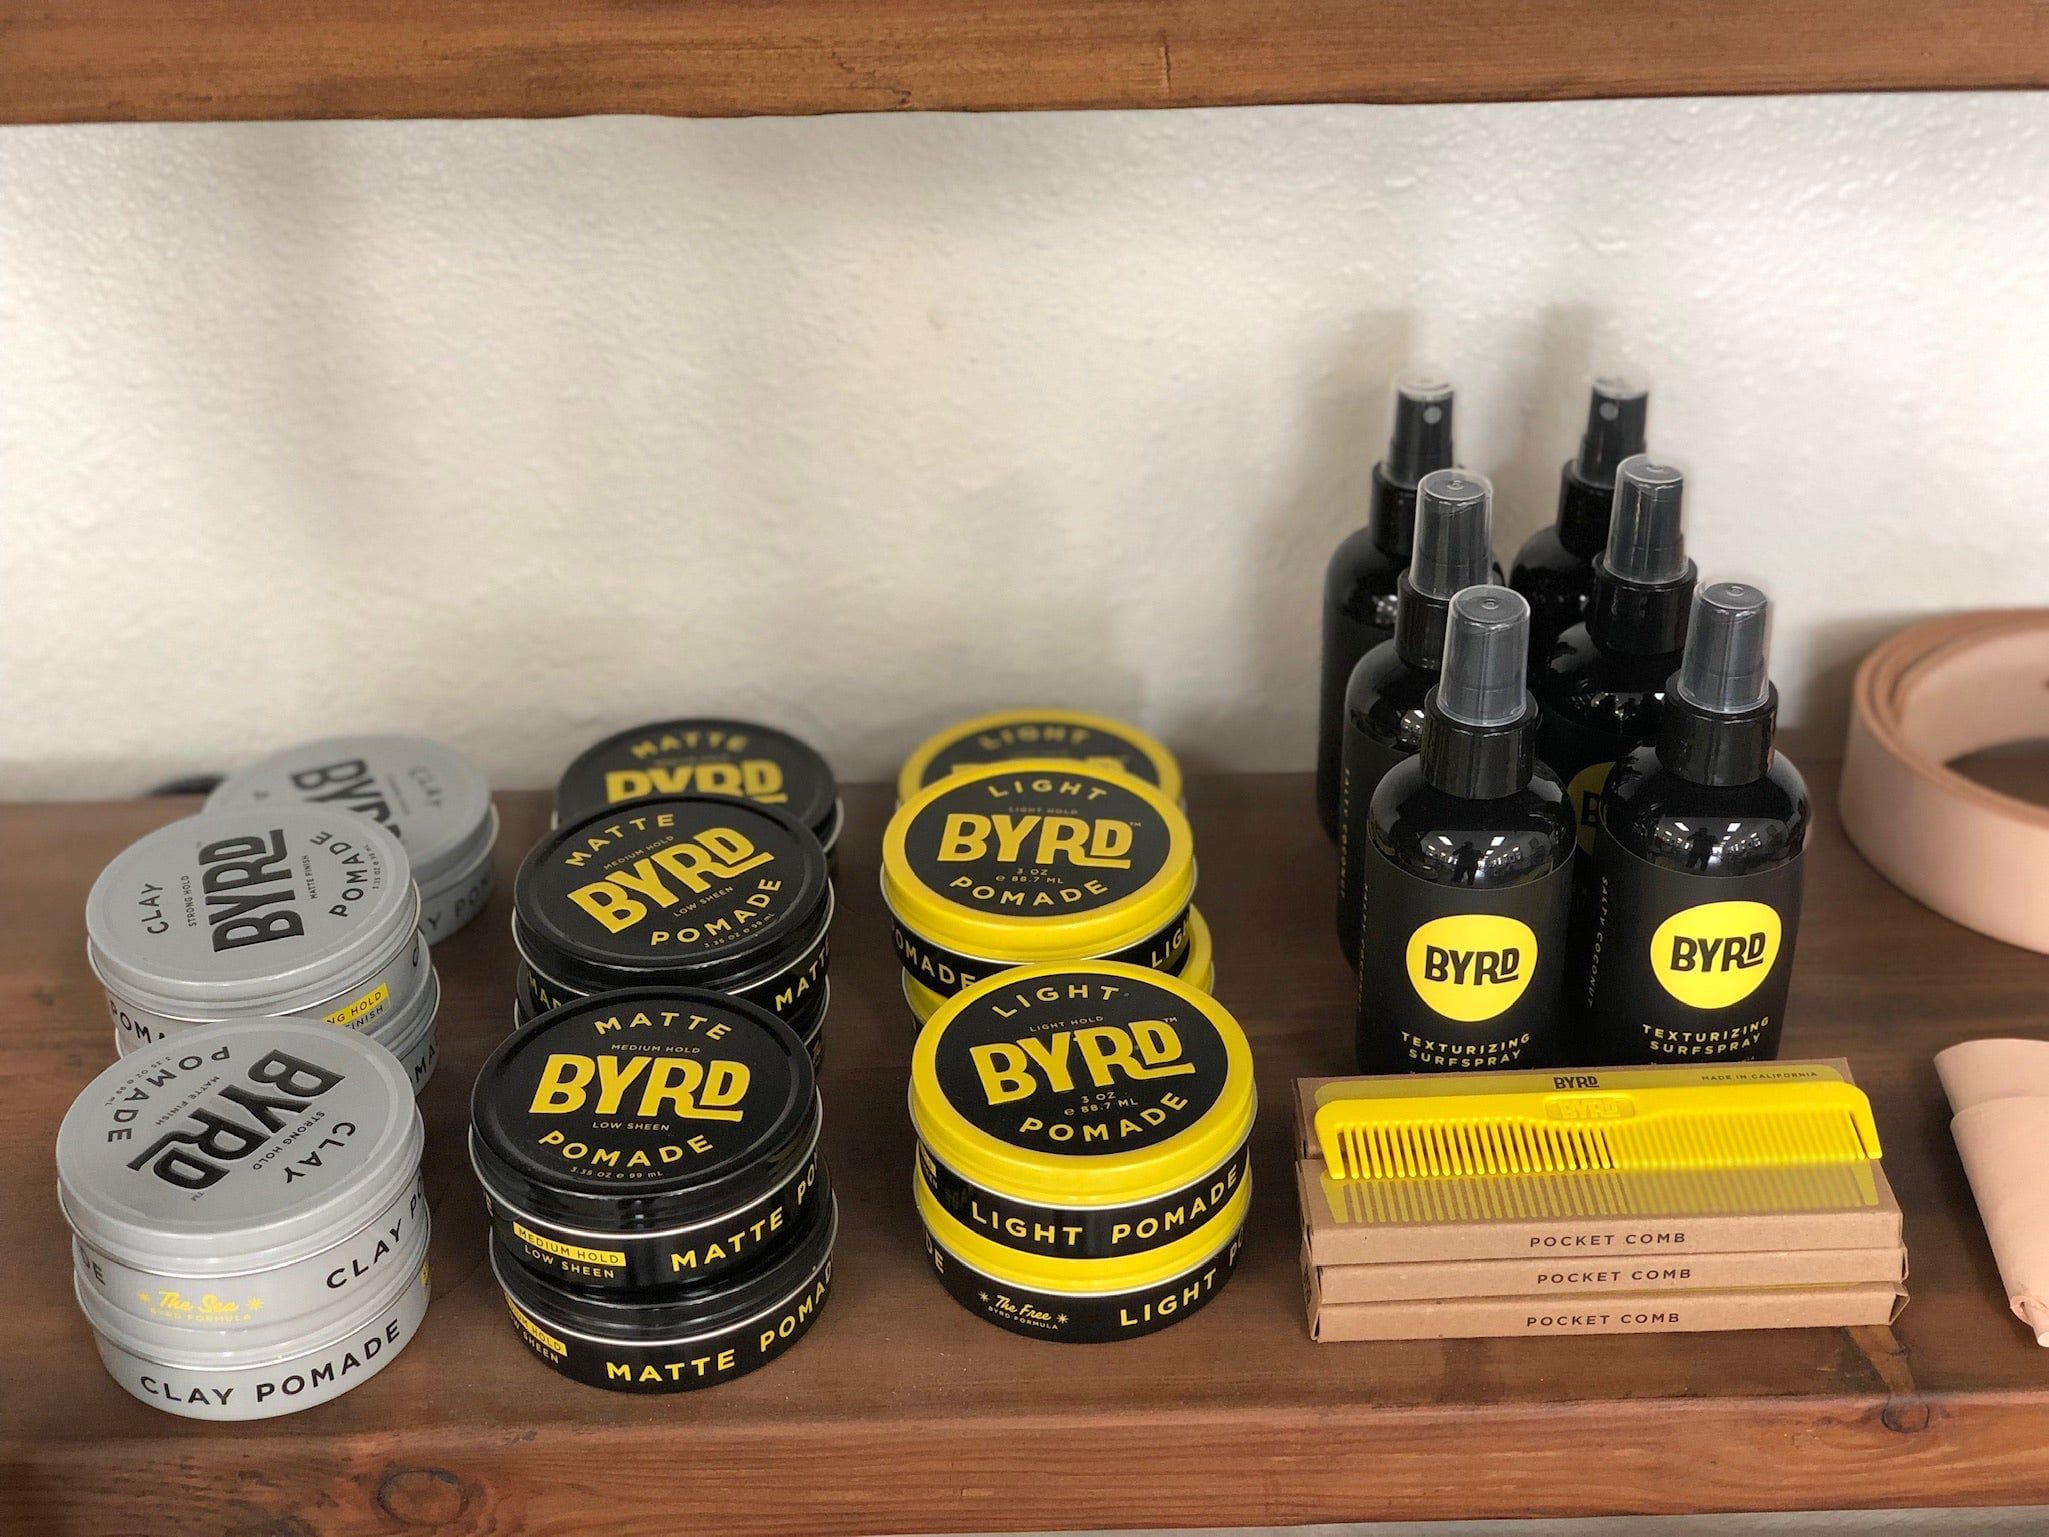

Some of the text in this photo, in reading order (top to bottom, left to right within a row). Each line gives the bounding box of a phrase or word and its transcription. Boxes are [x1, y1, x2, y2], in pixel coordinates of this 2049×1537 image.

[631, 730, 748, 759] MATTE
[988, 779, 1107, 800] LIGHT
[565, 813, 675, 868] MATTE
[603, 835, 675, 870] MEDIUM HOLD
[937, 813, 1133, 869] BYRD
[198, 829, 305, 952] BYRD
[302, 854, 319, 900] MATTE FINISH
[311, 831, 369, 918] POMADE
[567, 827, 775, 933] BYRD
[949, 876, 1109, 906] POMADE
[1046, 877, 1064, 885] ML
[138, 883, 170, 935] CLAY
[180, 875, 198, 928] STRONG HOLD
[650, 878, 782, 946] POMADE
[673, 886, 734, 918] LOW SHEEN
[892, 918, 976, 990] OMADE
[1423, 945, 1520, 986] BYRD
[1670, 932, 1767, 973] BYRD
[351, 990, 383, 1016] HOLD
[991, 984, 1120, 1019] LIGHT
[594, 1012, 732, 1041] MATTE
[1029, 1015, 1104, 1033] LIGHT HOLD
[1642, 1017, 1770, 1043] TEXTURIZING
[611, 1044, 701, 1054] MEDIUM HOLD
[1401, 1031, 1531, 1055] TEXTURIZING
[1408, 1048, 1521, 1067] SURFSPRAY
[1649, 1033, 1761, 1056] SURFSPRAY
[969, 1019, 1197, 1106] BYRD
[1701, 1074, 1732, 1082] MADE
[1751, 1071, 1818, 1080] CALIFORNIA
[108, 1046, 230, 1142] POMADE
[528, 1053, 751, 1122] BYRD
[1081, 1092, 1117, 1103] 3 OZ
[1553, 1076, 1599, 1090] BYRD
[155, 1076, 220, 1126] MATTE FINISH
[1019, 1091, 1189, 1143] POMADE
[1081, 1101, 1110, 1114] 88.7
[1118, 1097, 1139, 1108] ML
[126, 1049, 346, 1190] BYRD
[627, 1123, 670, 1131] SHEEN
[253, 1111, 325, 1171] STRONG HOLD
[284, 1122, 356, 1184] CLAY
[538, 1129, 714, 1169] POMADE
[597, 1171, 611, 1179] OZ
[971, 1164, 1237, 1246] LIGHT POMADE
[327, 1218, 401, 1289] CLAY
[518, 1227, 619, 1264] MEDIUM HOLD
[671, 1206, 784, 1272] MATTE
[1530, 1232, 1686, 1248] POCKET COMB
[524, 1244, 615, 1279] LOW SHEEN
[1537, 1268, 1692, 1285] POCKET COMB
[996, 1294, 1052, 1322] The Free
[1119, 1270, 1217, 1327] LIGHT
[1014, 1316, 1058, 1330] FORMULA
[1526, 1312, 1681, 1328] POCKET COMB
[523, 1331, 559, 1364] SHEEN
[532, 1325, 562, 1352] HOLD
[140, 1318, 401, 1406] CLAY POMADE
[606, 1349, 736, 1382] MATTE
